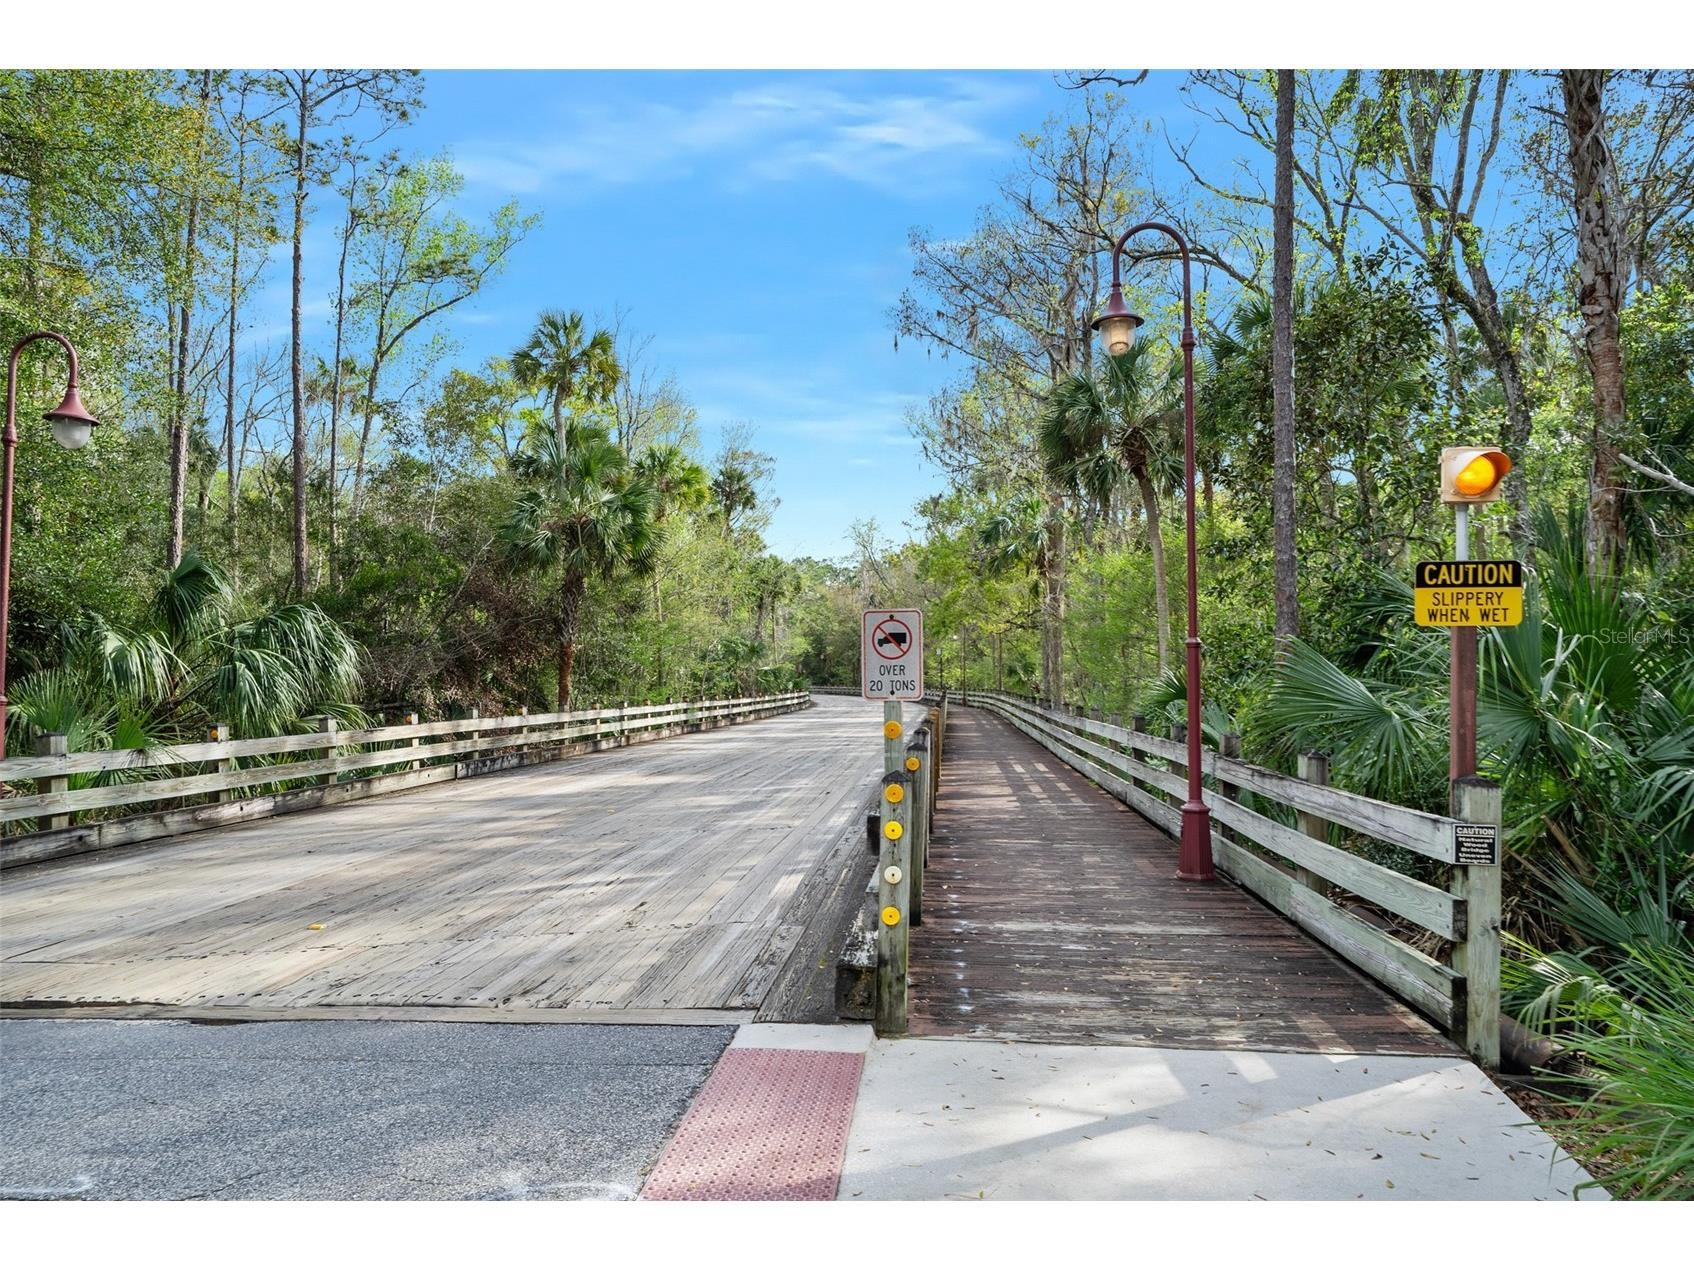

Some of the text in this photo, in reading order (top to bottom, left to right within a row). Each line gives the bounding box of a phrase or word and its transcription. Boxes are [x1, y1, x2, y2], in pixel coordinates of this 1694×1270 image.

[1424, 564, 1513, 585] CAUTION
[1432, 592, 1504, 606] SLIPPERY
[1427, 608, 1509, 622] WHEN WET
[879, 665, 906, 676] OVER
[869, 680, 916, 691] 20 TONS
[1456, 827, 1495, 835] CAUTION
